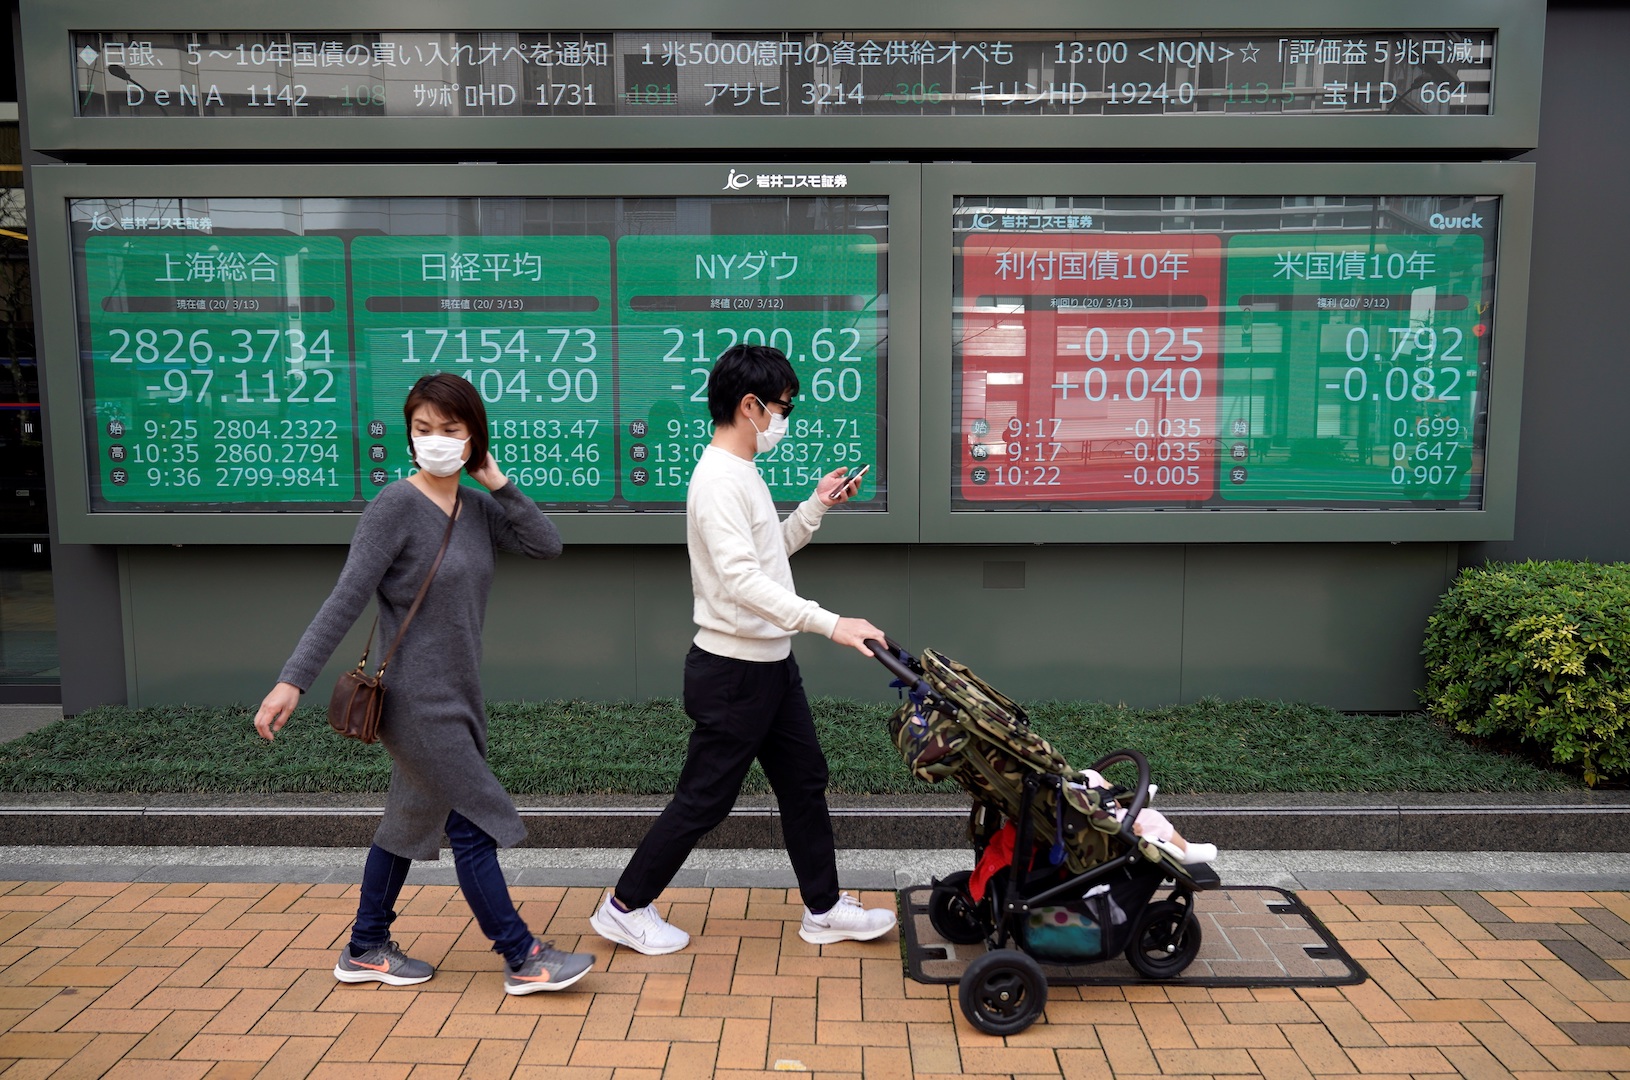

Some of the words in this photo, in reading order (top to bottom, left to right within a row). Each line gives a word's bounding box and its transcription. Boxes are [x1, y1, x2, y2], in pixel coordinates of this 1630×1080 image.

[1054, 41, 1128, 64] 13:00
[126, 84, 224, 107] DeNA
[246, 84, 309, 107] 1142
[328, 85, 387, 107] -108
[535, 84, 598, 107] 1731
[618, 84, 676, 106] -181
[703, 83, 781, 107] アサヒ
[801, 83, 865, 106] 3214
[884, 83, 943, 106] -306
[969, 82, 1087, 106] キリンHD
[1106, 82, 1195, 105] 1924.0
[1212, 82, 1296, 105] -113.5
[1322, 80, 1398, 105] 宝HD
[1420, 82, 1468, 105] 664
[757, 174, 847, 188] 岩井コスモ証券
[120, 217, 212, 229] 岩井コスモ証券
[1001, 215, 1093, 228] 岩井コスモ証券
[1429, 213, 1483, 229] Quick
[155, 252, 278, 282] 上海総合
[421, 252, 542, 282] 日経平均
[696, 250, 798, 280] NYダウ
[994, 251, 1189, 280] 利付国債10年
[1273, 251, 1436, 280] 米国債10年
[176, 300, 206, 310] 現在値
[209, 300, 229, 310] (20/
[233, 300, 259, 310] 3/13)
[441, 299, 470, 309] 現在値
[473, 299, 494, 310] (20/
[497, 299, 524, 310] 3/13)
[710, 299, 730, 309] 終値
[733, 299, 754, 309] (20/
[757, 299, 784, 309] 3/12)
[1050, 298, 1079, 308] 利回り
[1082, 298, 1103, 309] (20/
[1106, 298, 1133, 309] 3/13)
[1317, 298, 1336, 308] 複利
[1339, 298, 1360, 309] (20/
[1363, 298, 1390, 309] 3/12)
[108, 328, 335, 363] 2826.3734
[401, 329, 597, 363] 17154.73
[1066, 327, 1204, 361] -0.025
[1346, 327, 1464, 361] 0.792
[146, 369, 336, 403] -97.1122
[1051, 368, 1202, 401] +0.040
[1325, 367, 1461, 401] -0.082
[144, 420, 198, 439] 9:25
[214, 420, 338, 439] 2804.2322
[491, 420, 599, 439] 18183.47
[1008, 418, 1062, 437] 9:17
[1125, 418, 1201, 437] -0.035
[1394, 418, 1459, 437] 0.699
[112, 447, 124, 459] 高
[133, 444, 199, 463] 10:35
[215, 444, 339, 463] 2860.2794
[372, 447, 384, 459] 高
[492, 444, 599, 463] 18184.46
[633, 447, 645, 458] 高
[1008, 442, 1062, 461] 9:17
[1125, 442, 1200, 461] -0.035
[1234, 446, 1246, 457] 高
[1392, 442, 1459, 461] 0.647
[114, 470, 125, 483] 安
[147, 468, 201, 487] 9:36
[216, 468, 339, 487] 2799.9841
[373, 471, 385, 482] 安
[505, 467, 600, 486] 6690.60
[634, 470, 645, 482] 安
[974, 470, 987, 481] 安
[995, 466, 1061, 485] 10:22
[1124, 466, 1199, 485] -0.005
[1233, 470, 1244, 481] 安
[1391, 465, 1457, 485] 0.907
